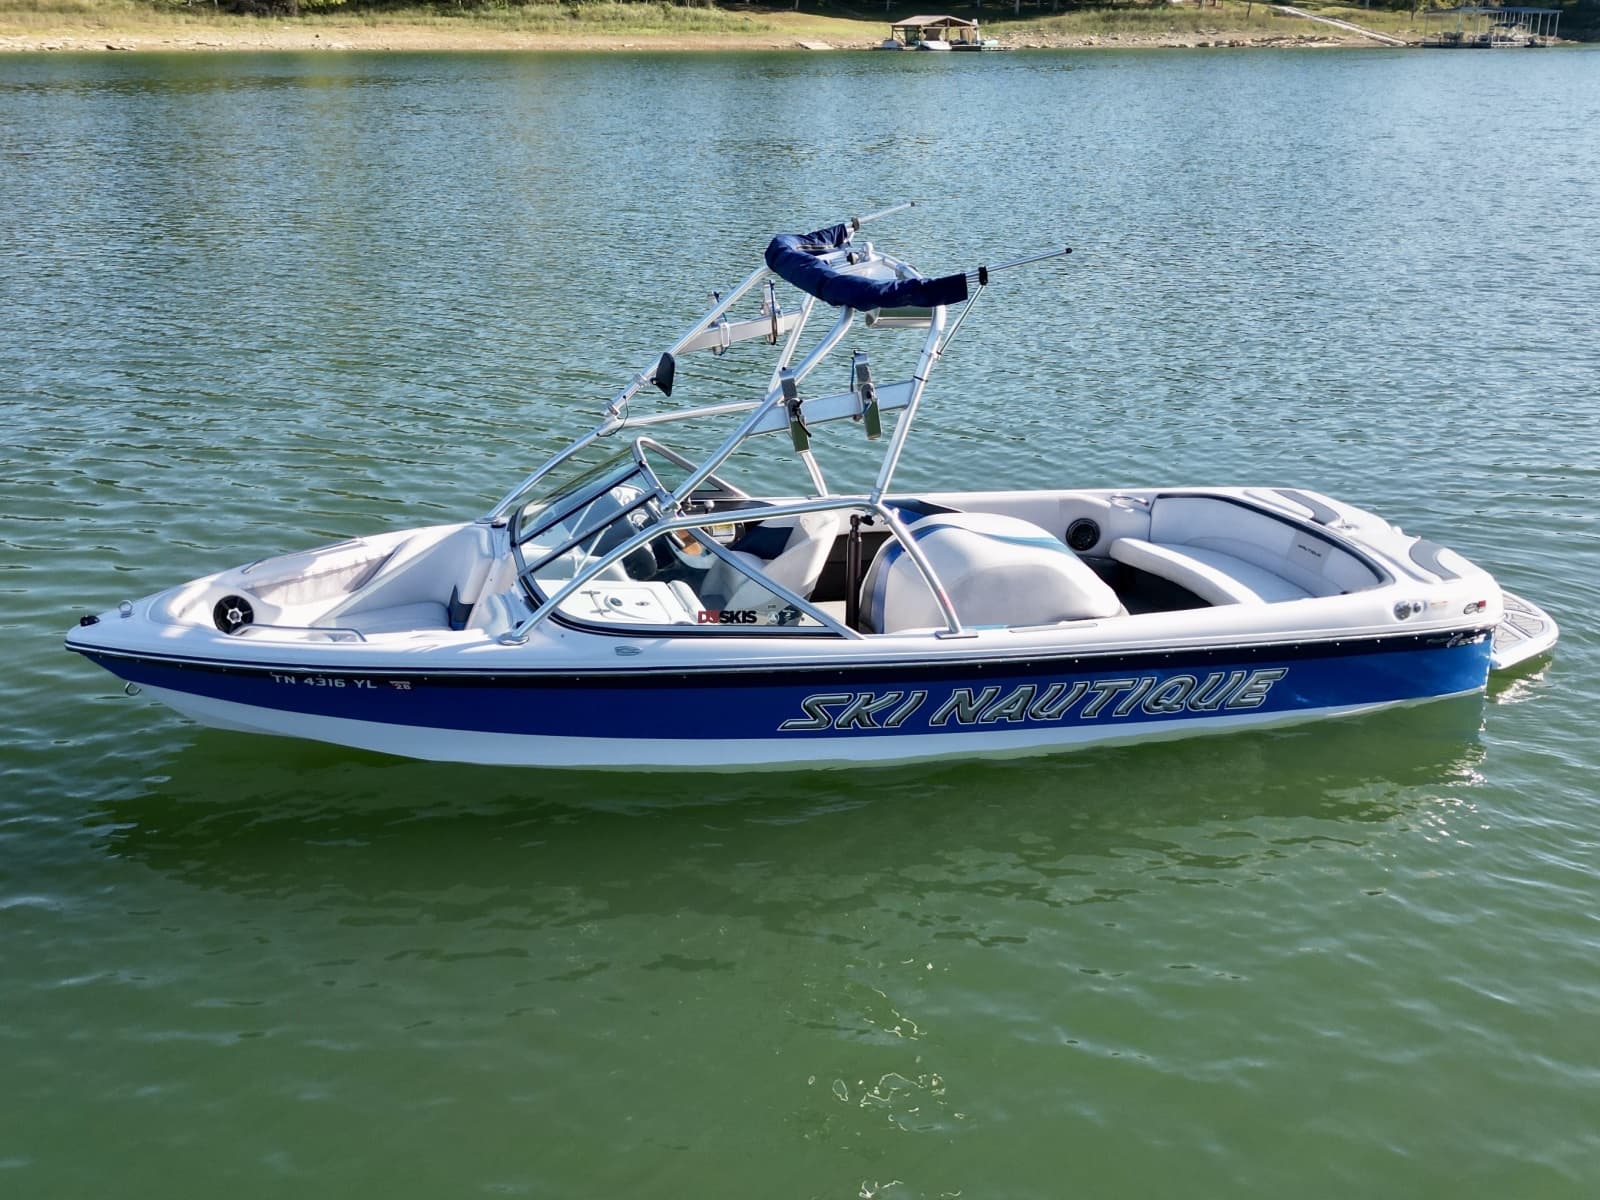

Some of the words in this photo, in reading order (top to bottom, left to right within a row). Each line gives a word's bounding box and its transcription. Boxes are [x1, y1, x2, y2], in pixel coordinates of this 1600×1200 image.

[271, 674, 296, 685] TN
[303, 676, 347, 688] 4316
[353, 679, 378, 689] YL
[777, 689, 928, 731] SKI
[928, 667, 1289, 727] NAUTIQUE
